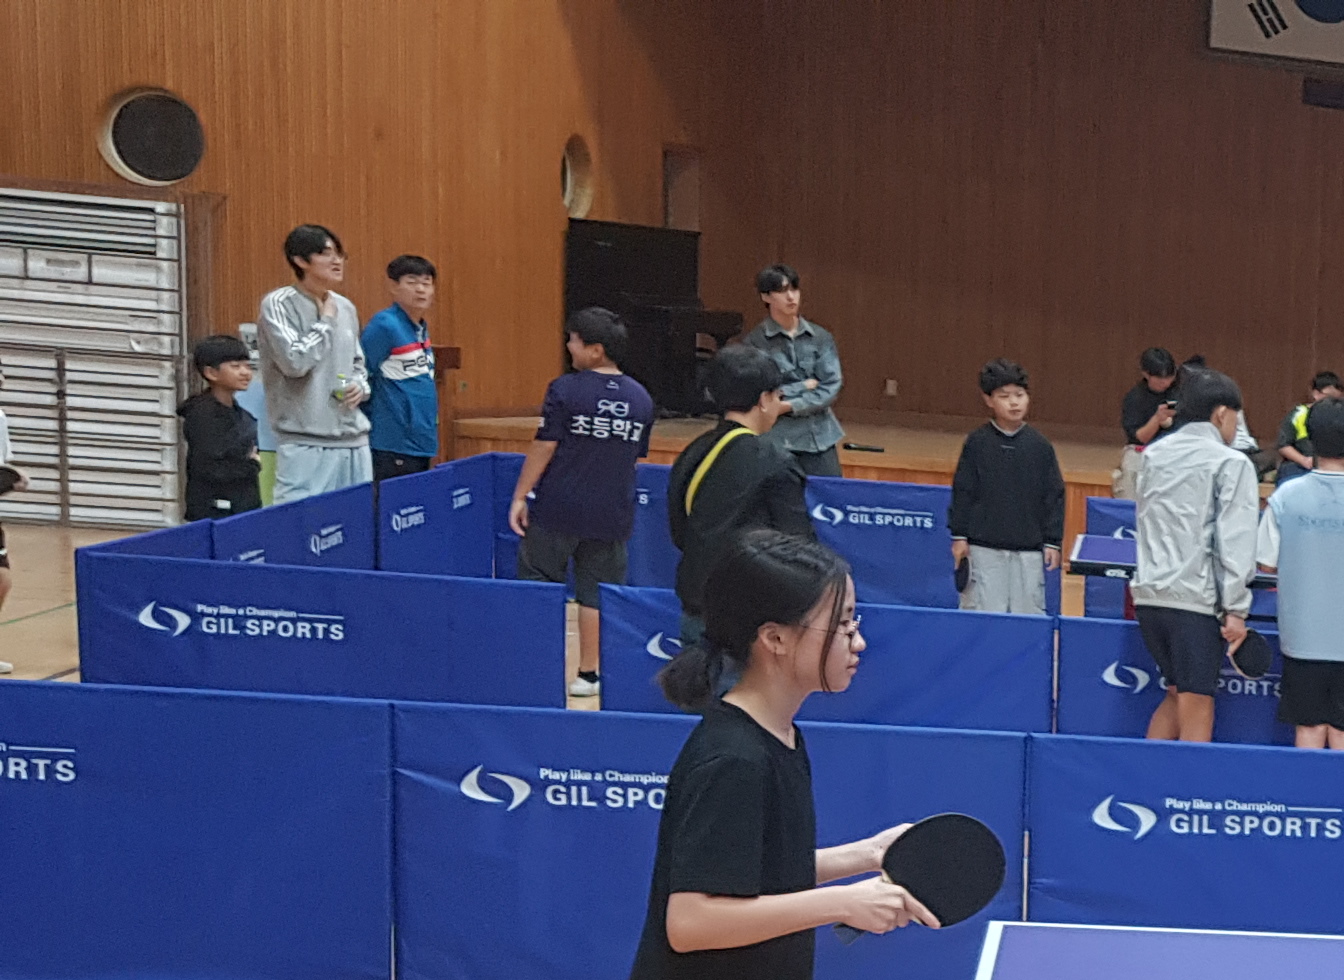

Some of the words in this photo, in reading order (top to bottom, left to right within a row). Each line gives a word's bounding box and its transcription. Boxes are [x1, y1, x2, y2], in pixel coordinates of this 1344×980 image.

[875, 514, 933, 528] SPORTS
[201, 616, 240, 636] GIL
[245, 618, 344, 641] SPORTS
[0, 757, 76, 782] RTS
[539, 767, 568, 782] Play
[545, 784, 598, 807] GIL
[605, 786, 666, 810] SPO
[1165, 797, 1191, 811] Play
[1224, 799, 1286, 814] Champion
[1169, 813, 1217, 834] GIL
[1224, 815, 1342, 839] SPORTS
